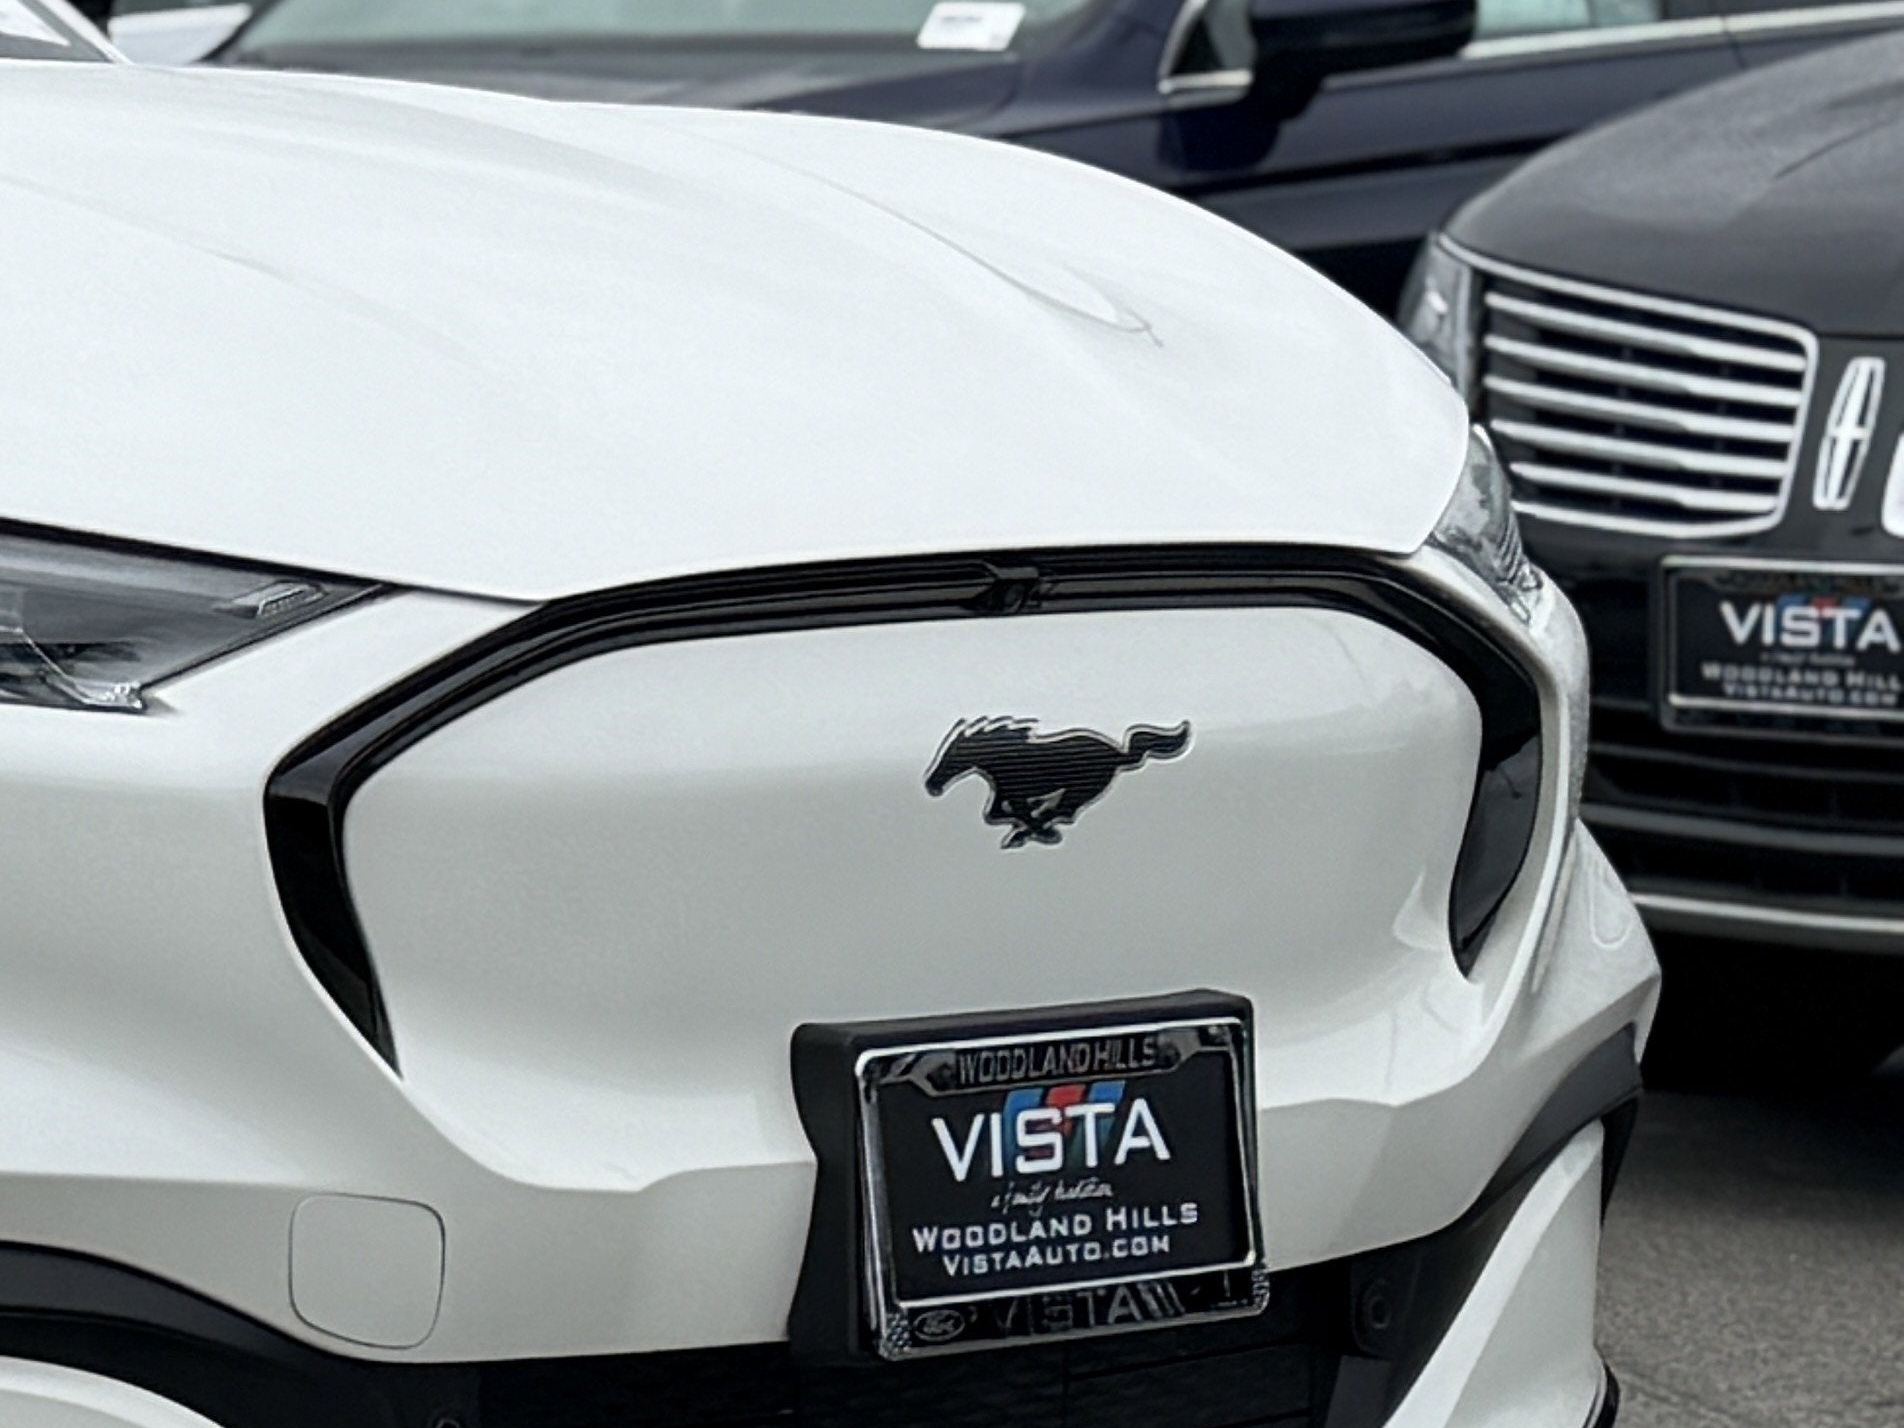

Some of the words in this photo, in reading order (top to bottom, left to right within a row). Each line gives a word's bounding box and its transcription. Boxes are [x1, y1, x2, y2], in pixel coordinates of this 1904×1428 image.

[1719, 600, 1902, 653] VISTA
[1844, 668, 1904, 692] HILL
[955, 1040, 1091, 1085] WOODLAND
[1093, 1034, 1157, 1073] HILLS
[931, 1097, 1171, 1182] VISTA
[913, 1217, 1094, 1254] WOODLAND
[1106, 1203, 1199, 1231] HILLS
[995, 1281, 1143, 1335] VISTA
